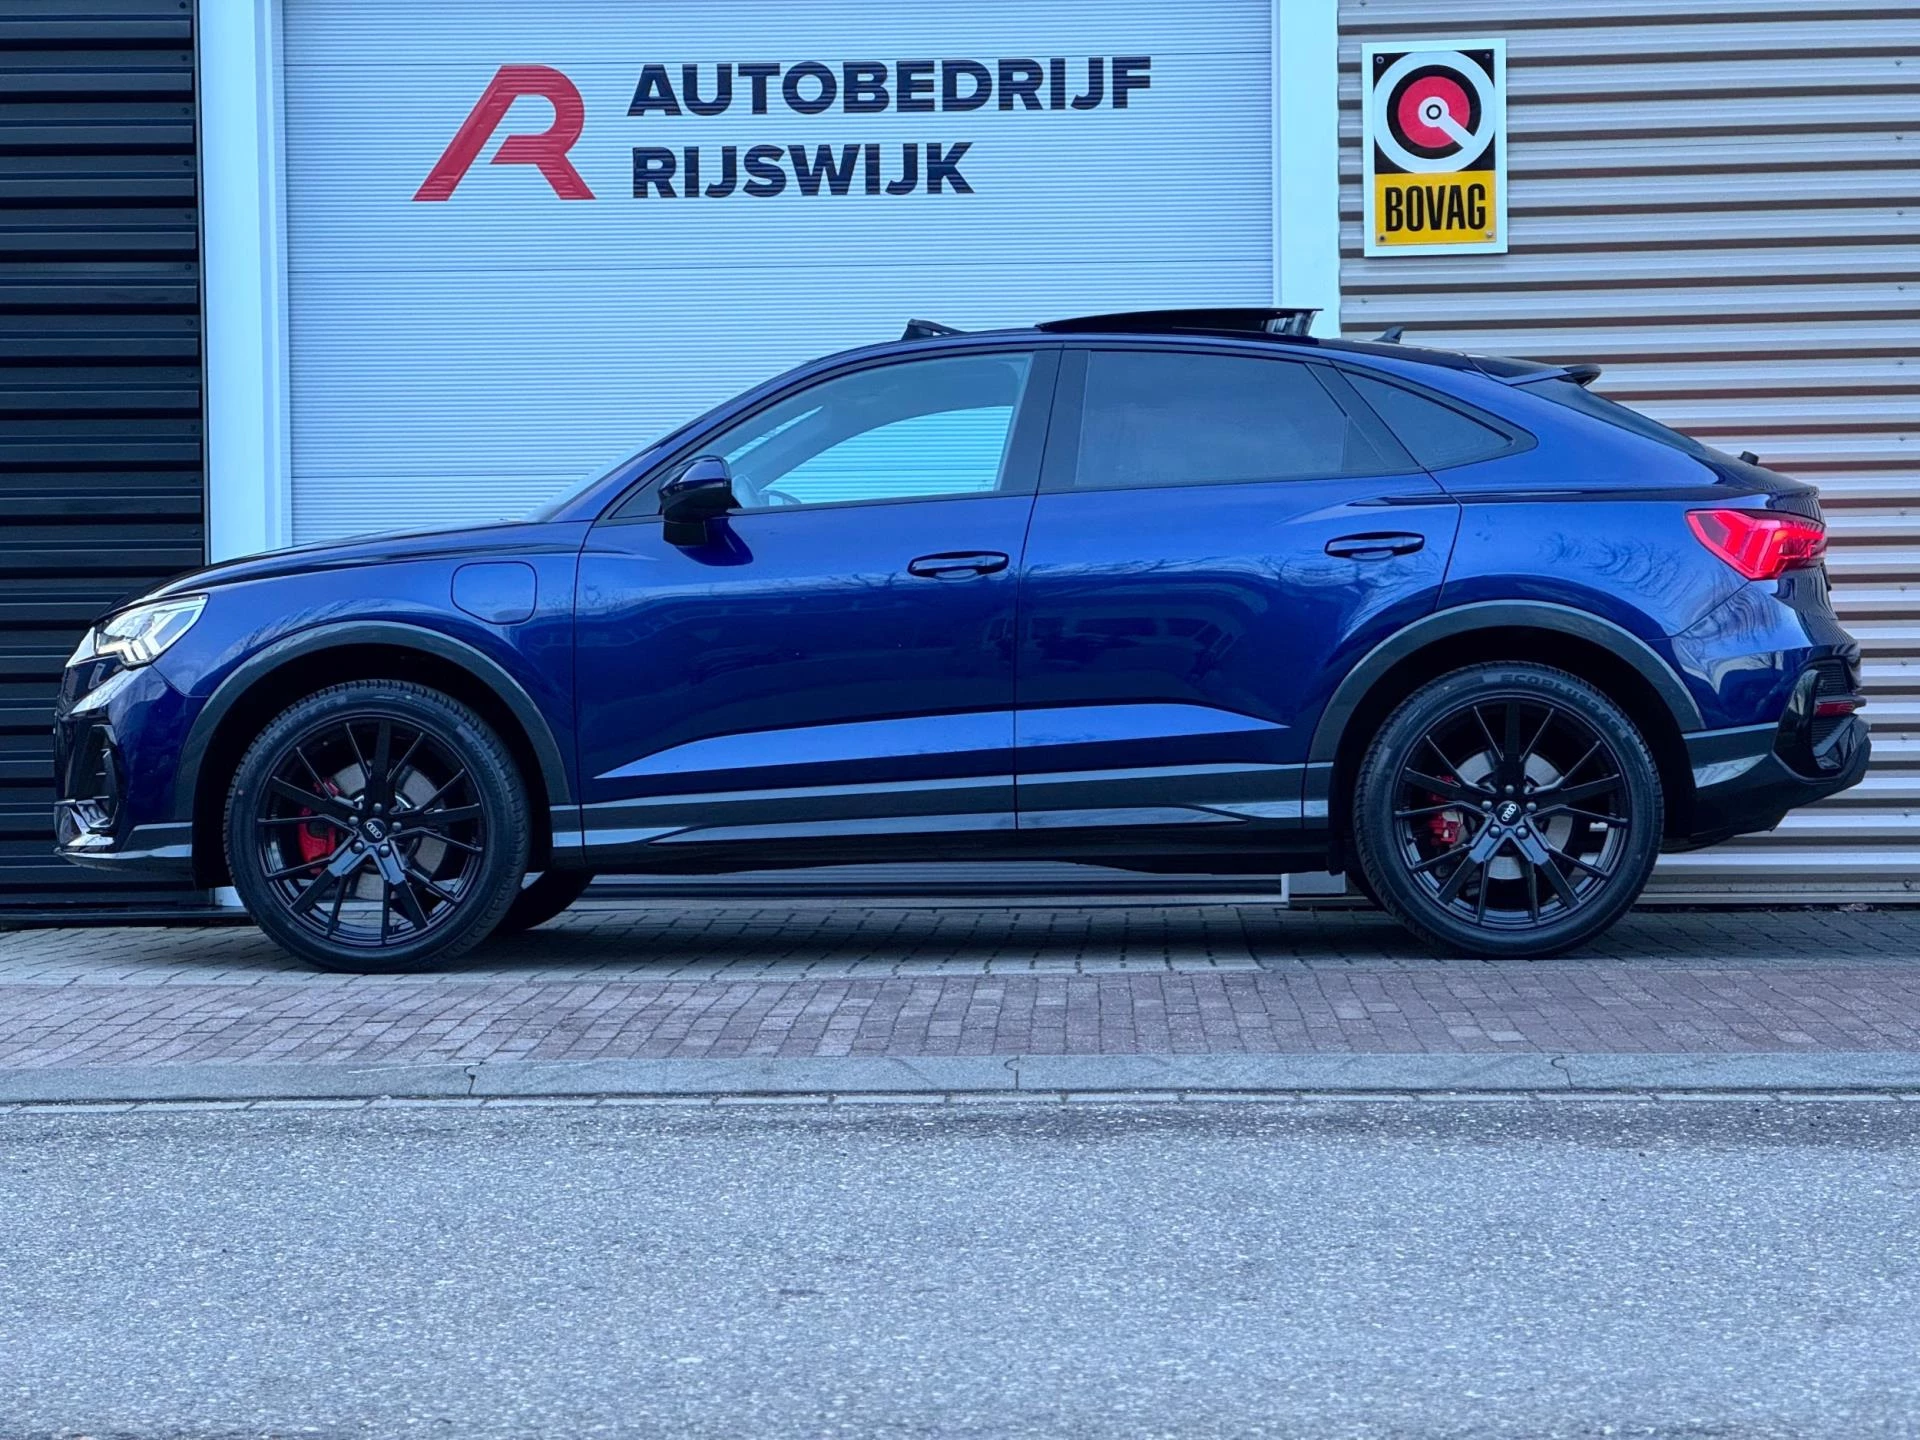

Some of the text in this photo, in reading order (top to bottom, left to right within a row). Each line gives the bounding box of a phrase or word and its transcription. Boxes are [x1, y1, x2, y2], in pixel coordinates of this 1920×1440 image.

[627, 56, 1151, 117] AUTOBEDRIJF
[633, 143, 972, 198] RIJSWIJK
[1385, 183, 1486, 232] BOVAG
